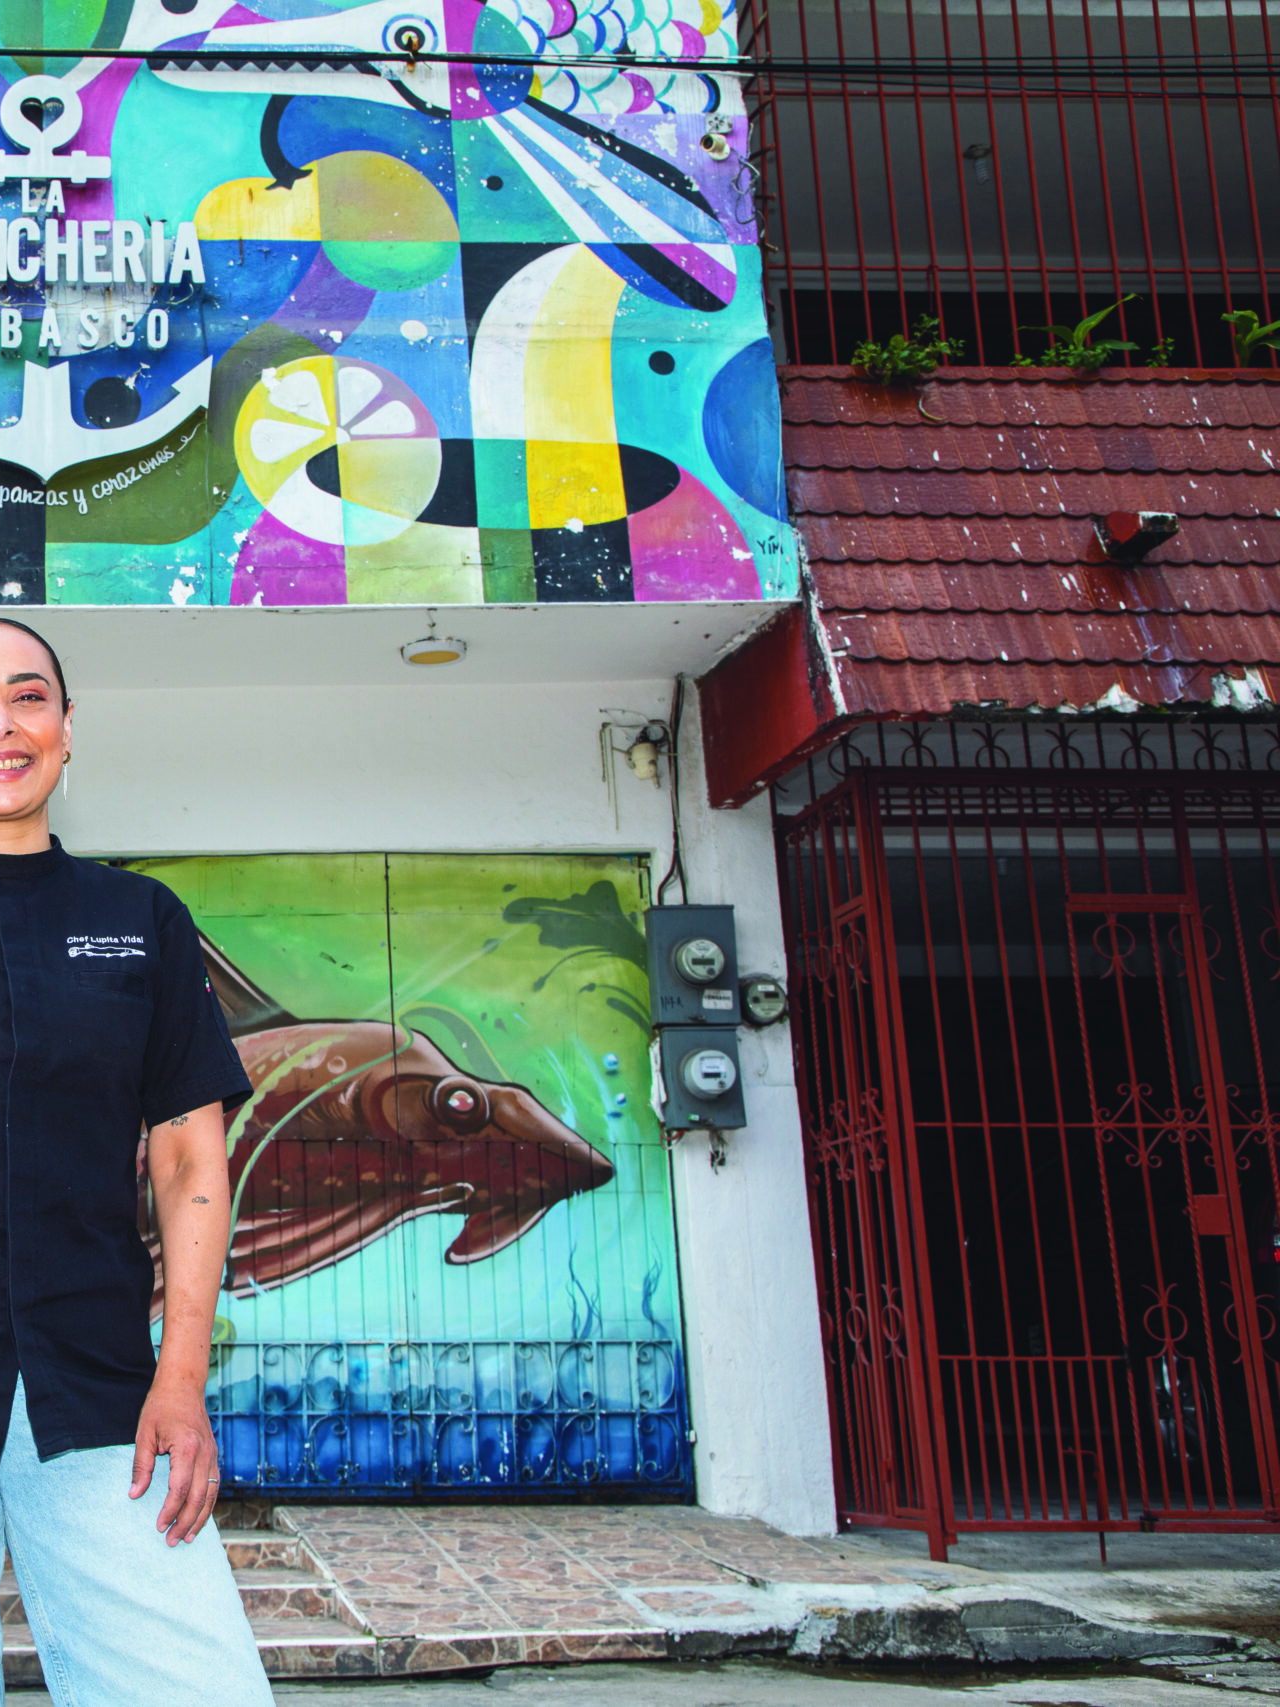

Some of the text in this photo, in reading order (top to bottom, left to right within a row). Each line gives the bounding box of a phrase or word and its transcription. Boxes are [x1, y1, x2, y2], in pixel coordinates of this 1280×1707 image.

[21, 179, 66, 213] LA
[72, 488, 88, 515] y
[91, 446, 175, 500] corazones
[66, 935, 144, 944] Chef Lupita Vidal
